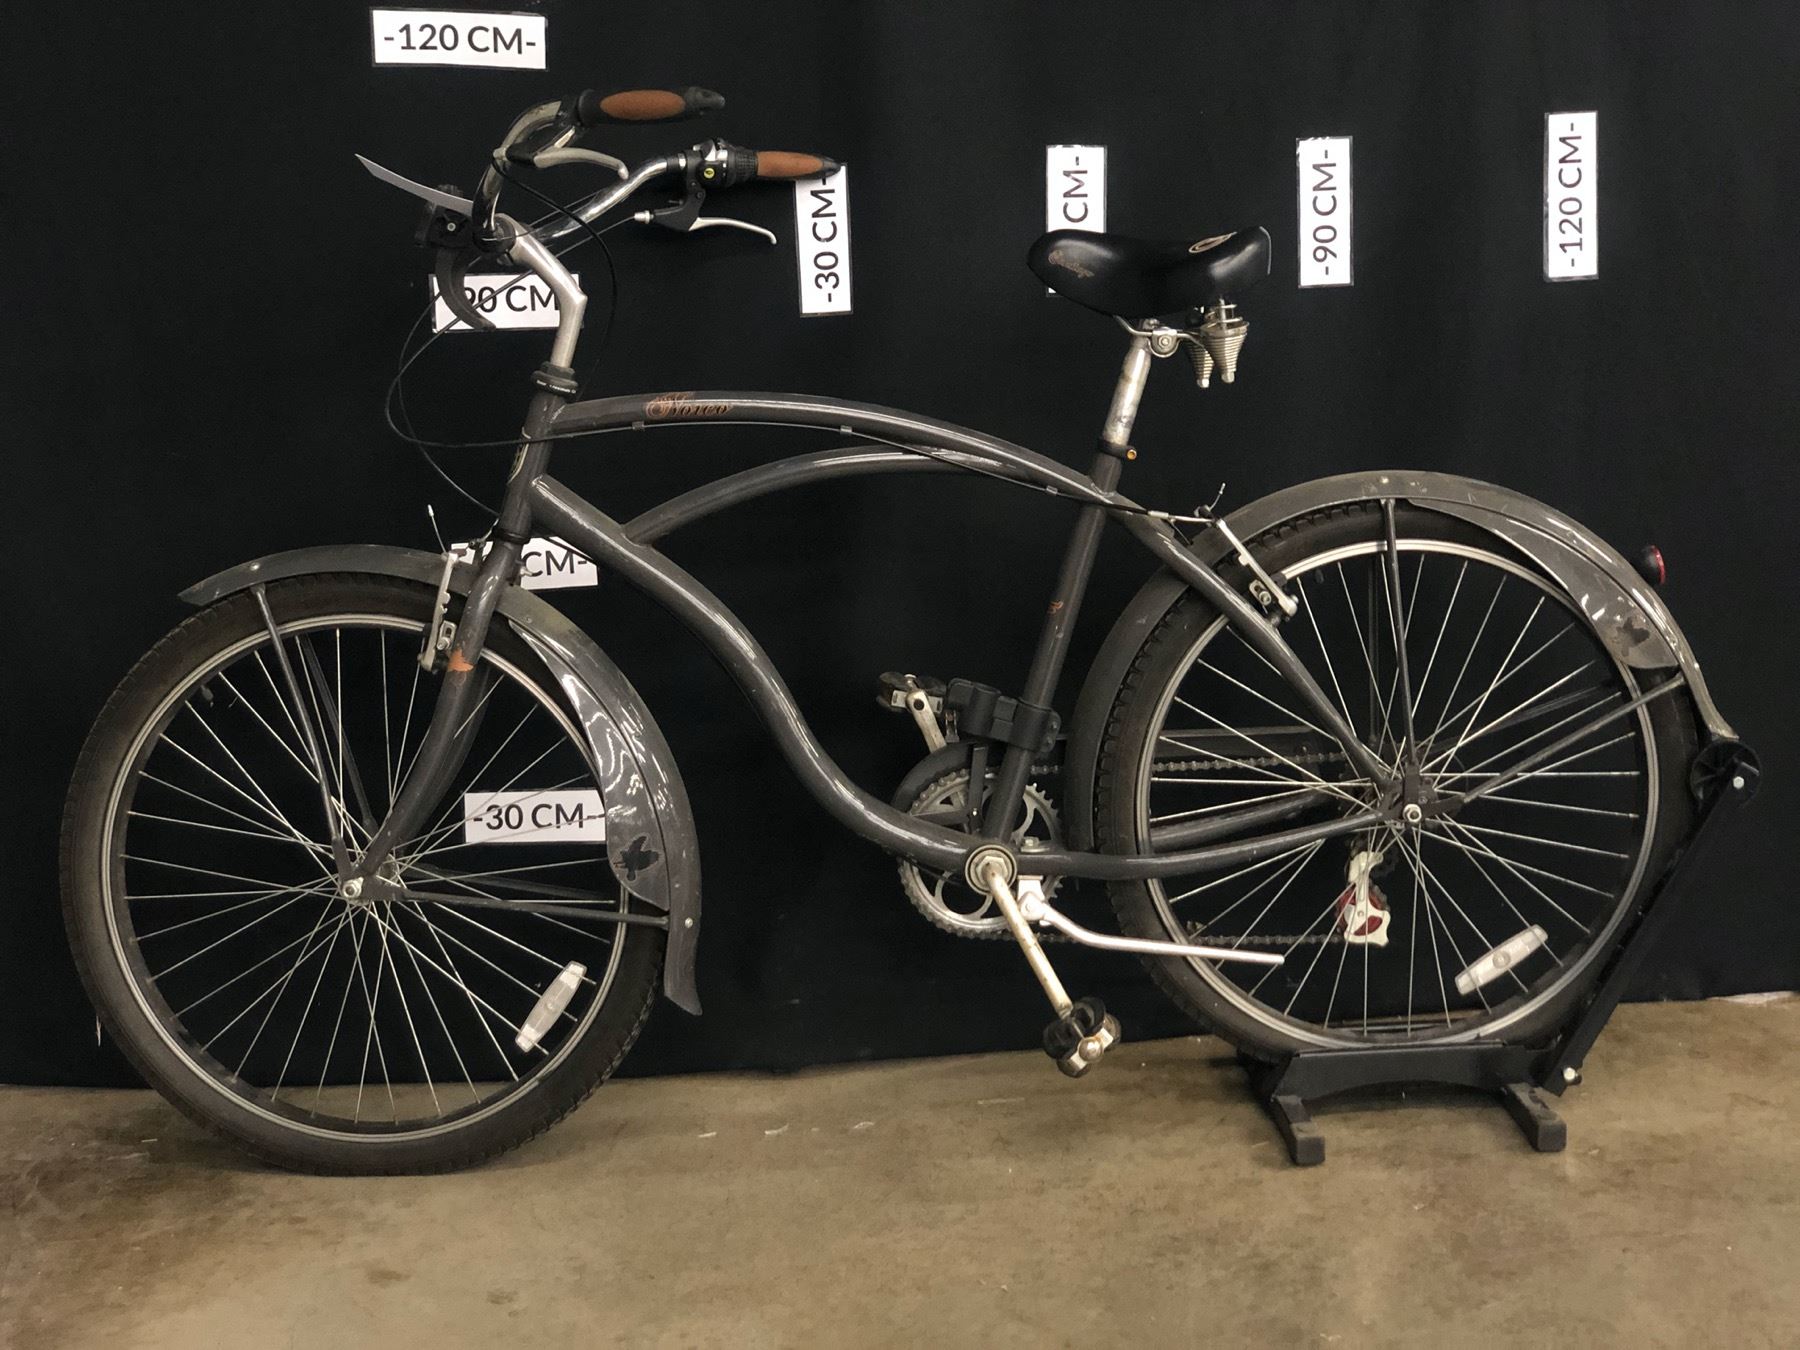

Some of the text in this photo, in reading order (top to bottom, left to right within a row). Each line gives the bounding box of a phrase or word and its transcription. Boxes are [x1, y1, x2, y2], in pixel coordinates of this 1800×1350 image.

[383, 23, 537, 55] -120 CM-
[1062, 156, 1089, 223] CM-
[1312, 149, 1338, 276] -90 CM-
[1558, 122, 1583, 267] -120 CM-
[810, 177, 840, 303] -30 CM-
[505, 284, 560, 312] CM
[521, 550, 588, 577] CM-
[473, 803, 598, 830] -30 CM-
